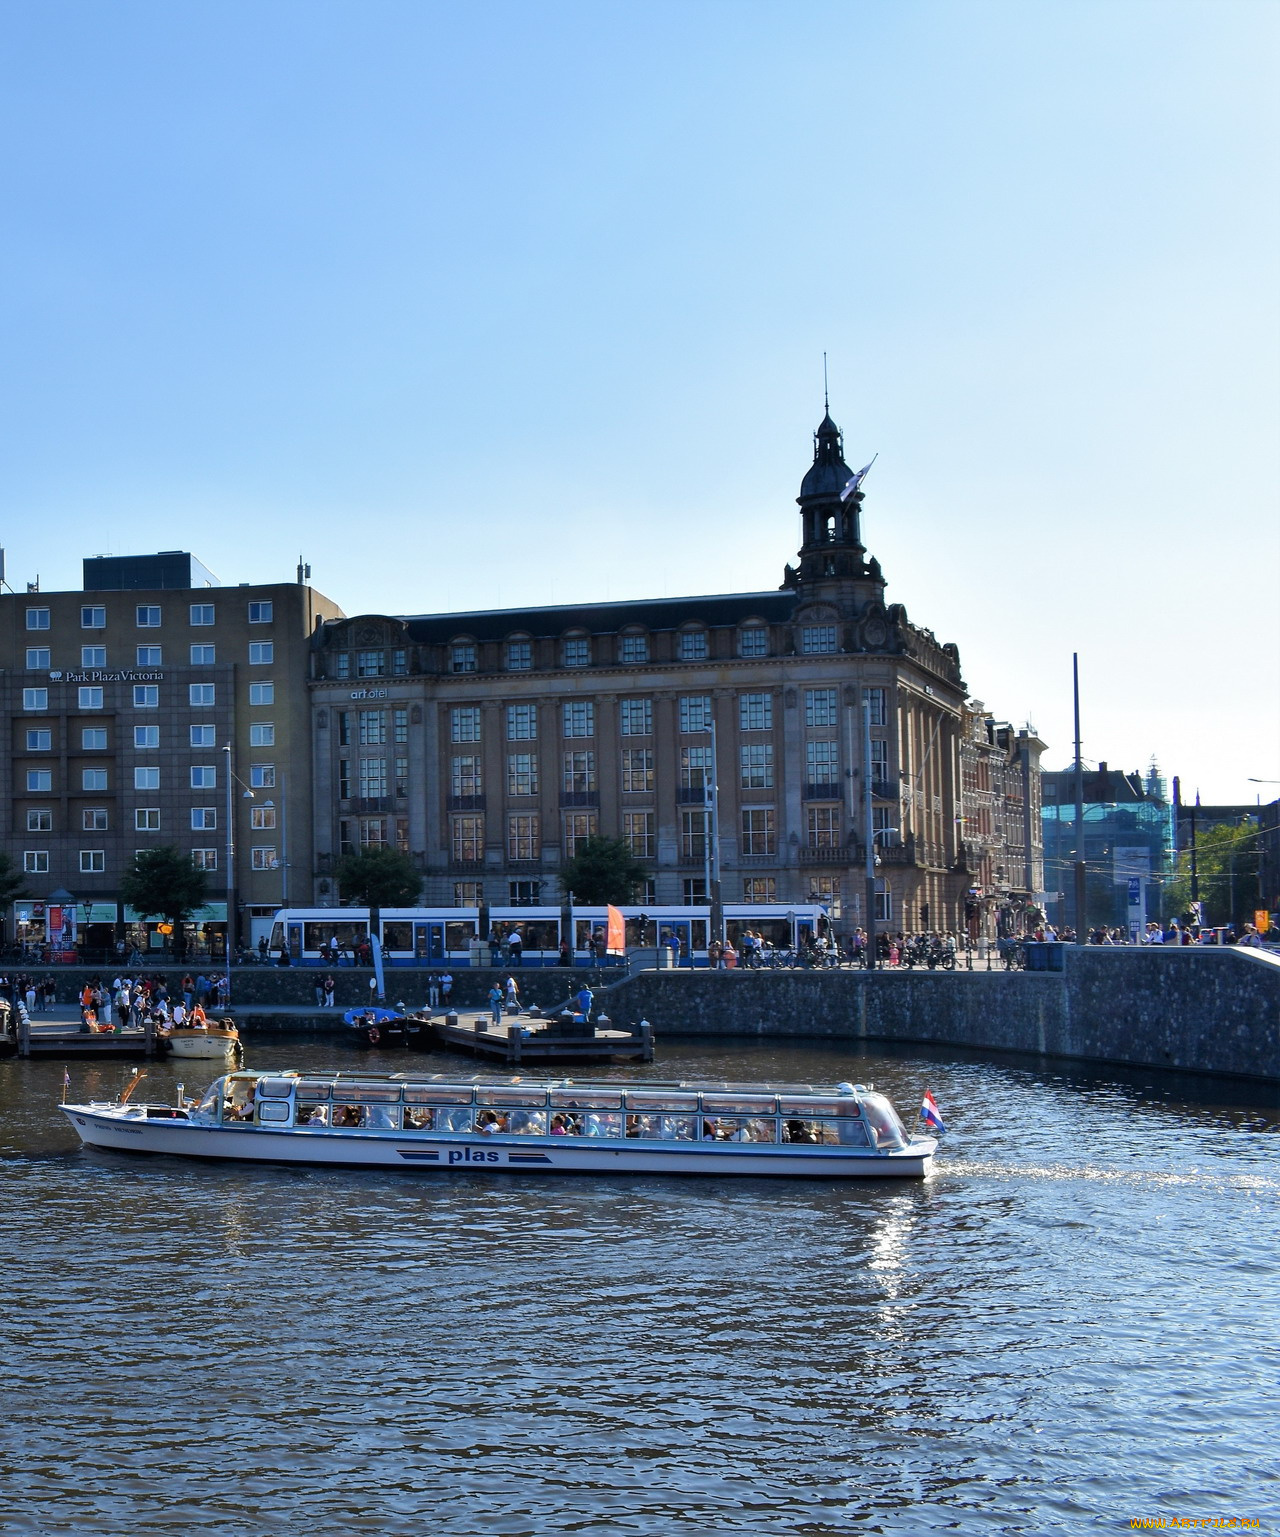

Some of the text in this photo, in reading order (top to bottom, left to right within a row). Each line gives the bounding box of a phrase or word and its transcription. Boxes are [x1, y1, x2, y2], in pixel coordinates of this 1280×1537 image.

[66, 669, 164, 682] Park Plaza Victoria
[448, 1147, 499, 1164] plas
